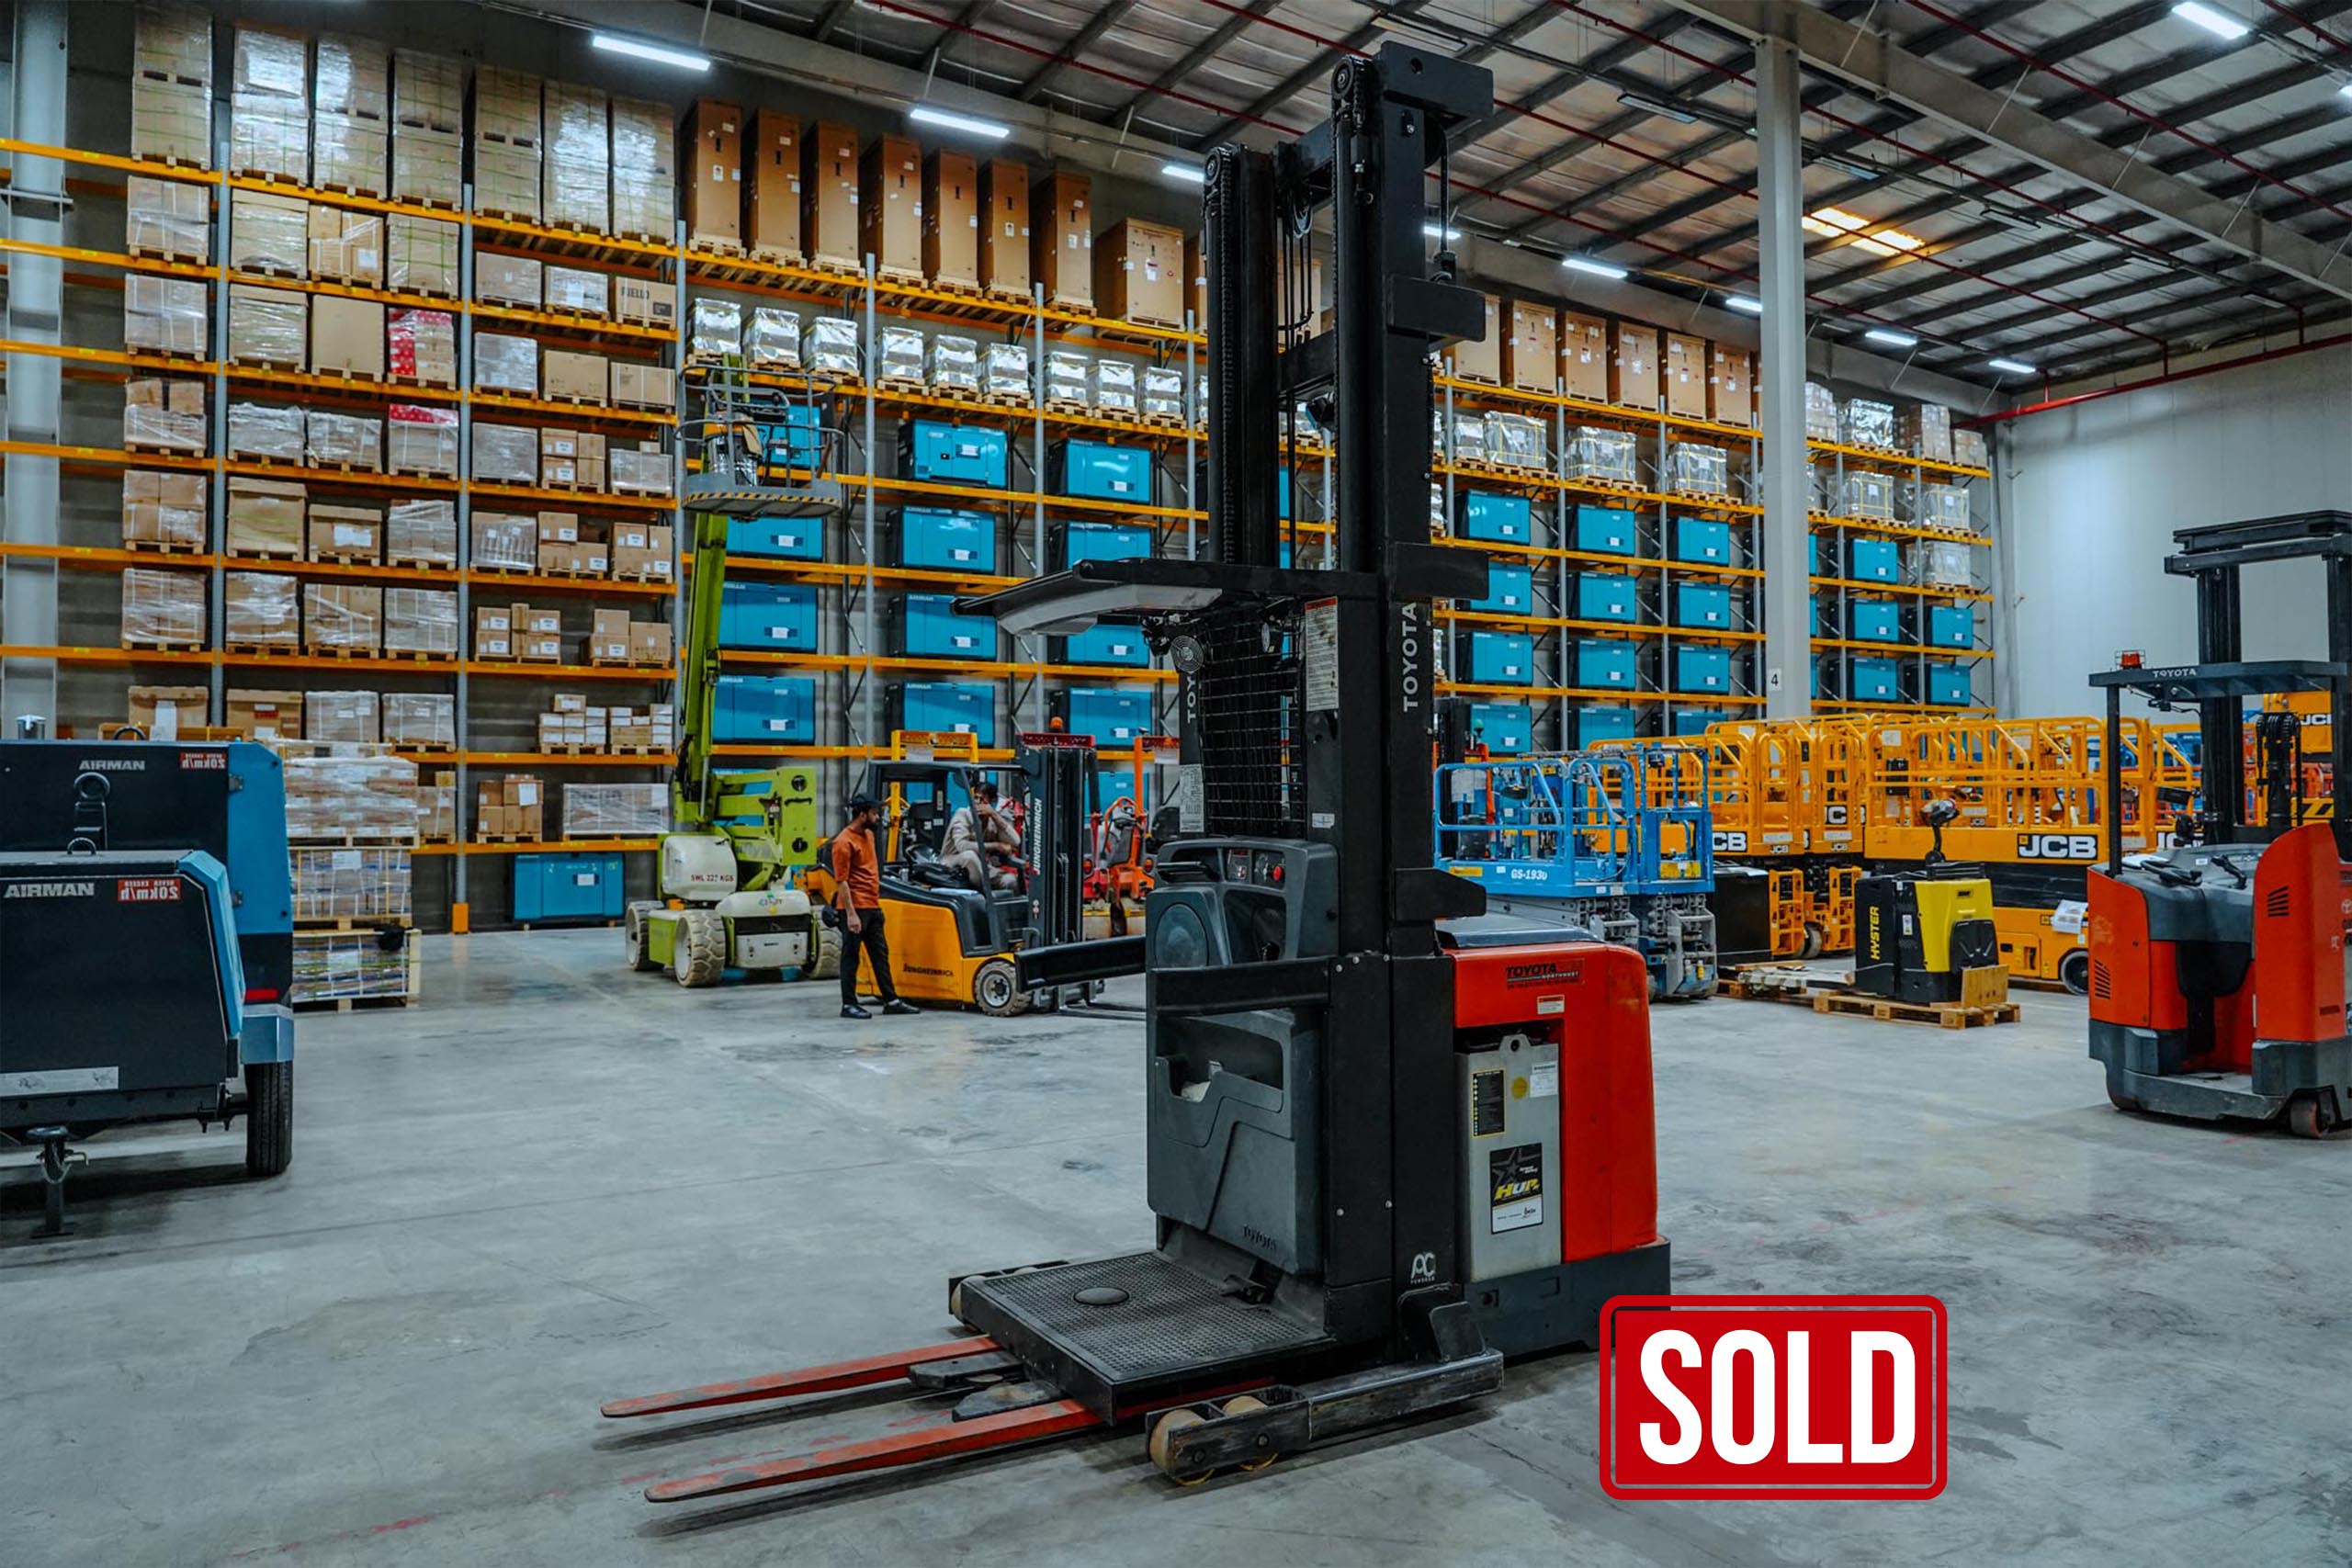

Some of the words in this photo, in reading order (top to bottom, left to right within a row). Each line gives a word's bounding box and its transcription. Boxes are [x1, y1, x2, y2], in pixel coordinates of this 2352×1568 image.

[1402, 602, 1419, 712] TOYOTA
[1770, 673, 1779, 687] 4
[2153, 668, 2197, 679] TOYOTA
[79, 760, 146, 771] AIRMAN
[1033, 797, 1043, 875] JUNGHEINRICH
[1712, 831, 1747, 852] CB
[1770, 845, 1789, 854] JCB
[2018, 835, 2098, 859] JCB
[4, 883, 95, 898] AIRMAN
[1870, 906, 1881, 961] HYSTER
[1506, 963, 1556, 978] TOYOTA
